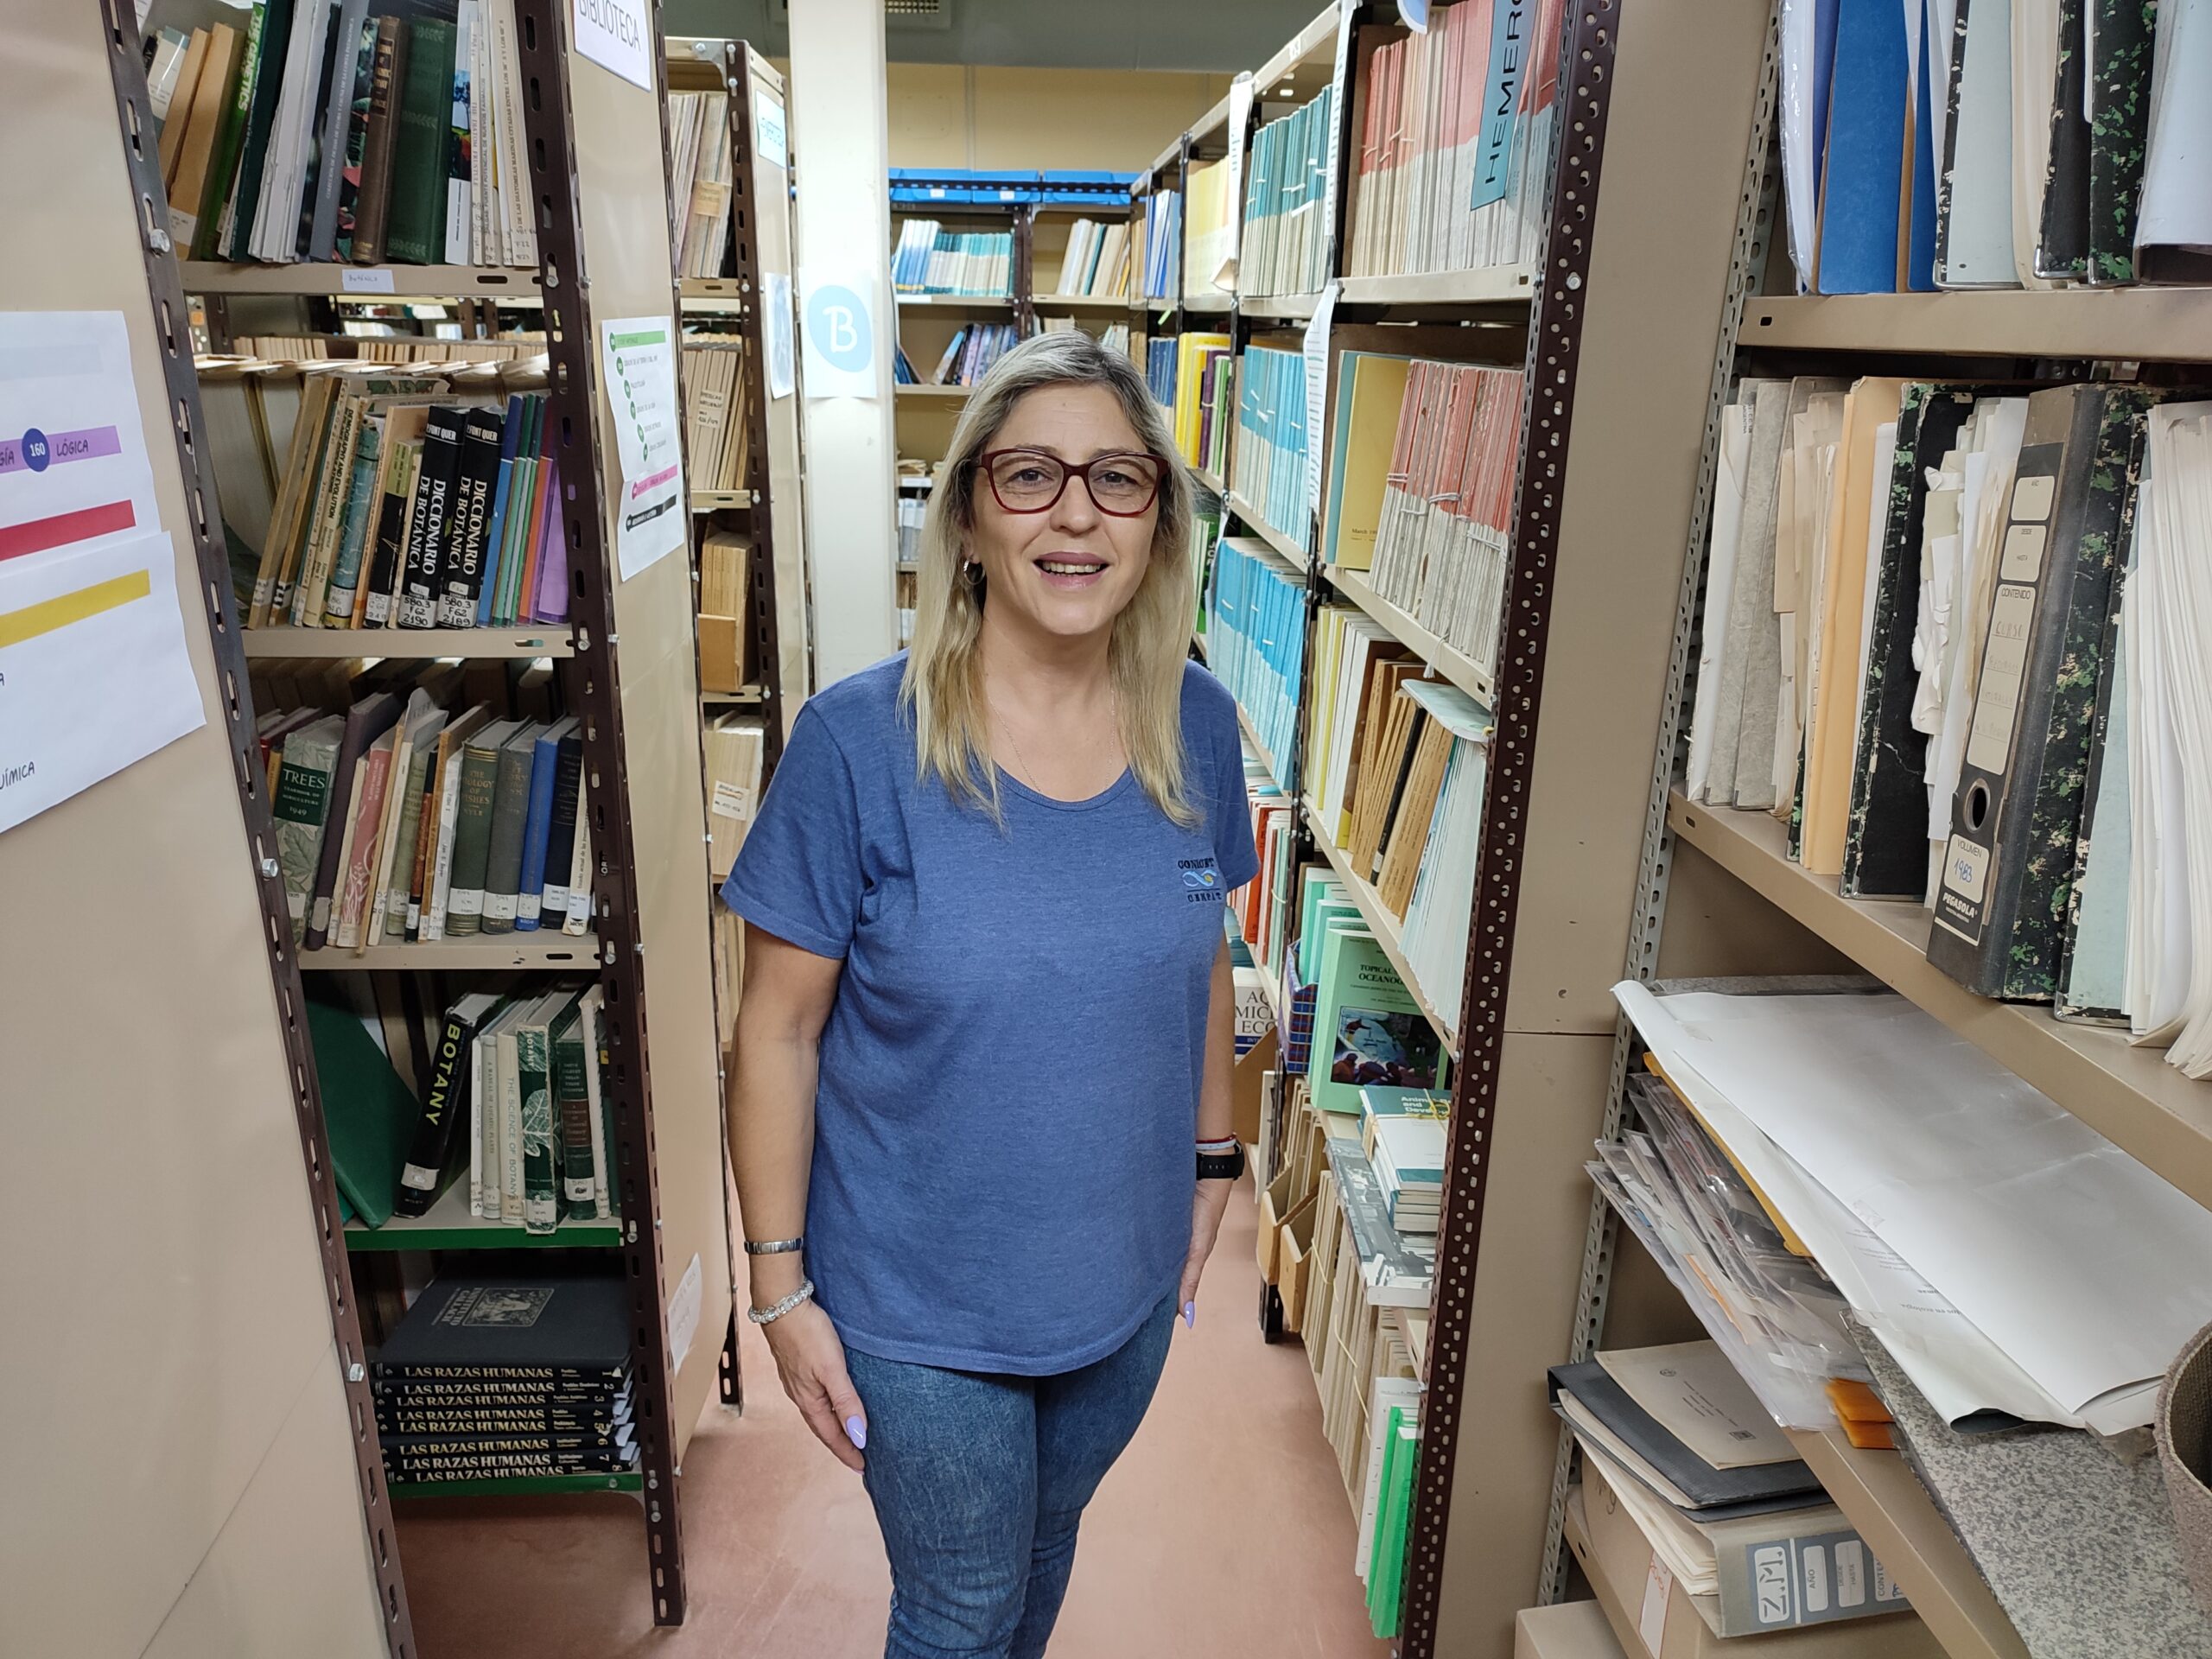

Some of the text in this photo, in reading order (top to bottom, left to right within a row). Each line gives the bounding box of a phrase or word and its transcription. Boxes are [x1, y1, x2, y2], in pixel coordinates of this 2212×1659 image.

[1485, 0, 1522, 184] HEMER
[823, 305, 857, 353] B
[340, 410, 353, 461] DEMOGRAPHY
[440, 428, 457, 441] QUER
[480, 429, 498, 441] QUER
[29, 442, 46, 457] 160
[56, 438, 89, 457] LÓGICA
[336, 462, 346, 476] AND
[328, 479, 341, 518] EVOLUTION
[408, 475, 430, 570] DE BOTÁNICA
[422, 479, 447, 575] DICCIONARIO
[448, 475, 472, 570] DE BOTÁNICA
[463, 480, 487, 575] DICCIONARIO
[404, 596, 431, 609] 580.3
[444, 596, 472, 609] 580.3
[403, 614, 429, 626] 2190
[442, 614, 471, 626] 2189
[283, 768, 325, 789] TREES
[289, 805, 308, 817] 1949
[1957, 839, 1982, 858] VOLUMEN
[1954, 858, 1973, 883] 1983
[1942, 892, 1975, 918] PEGASOLA
[1360, 963, 1392, 975] TOPICAL
[426, 1023, 461, 1126] BOTANY
[509, 1142, 516, 1155] OF
[404, 1367, 554, 1377] LAS RAZAS HUMANAS
[404, 1382, 555, 1395] LAS RAZAS HUMANAS
[397, 1395, 545, 1406] LAS RAZAS HUMANAS
[397, 1409, 544, 1421] LAS RAZAS HUMANAS
[399, 1421, 546, 1432] LAS RAZAS HUMANAS
[399, 1439, 549, 1454] LAS RAZAS HUMANAS
[403, 1454, 550, 1469] LAS RAZAS HUMANAS
[416, 1466, 564, 1482] LAS RAZAS HUMANAS
